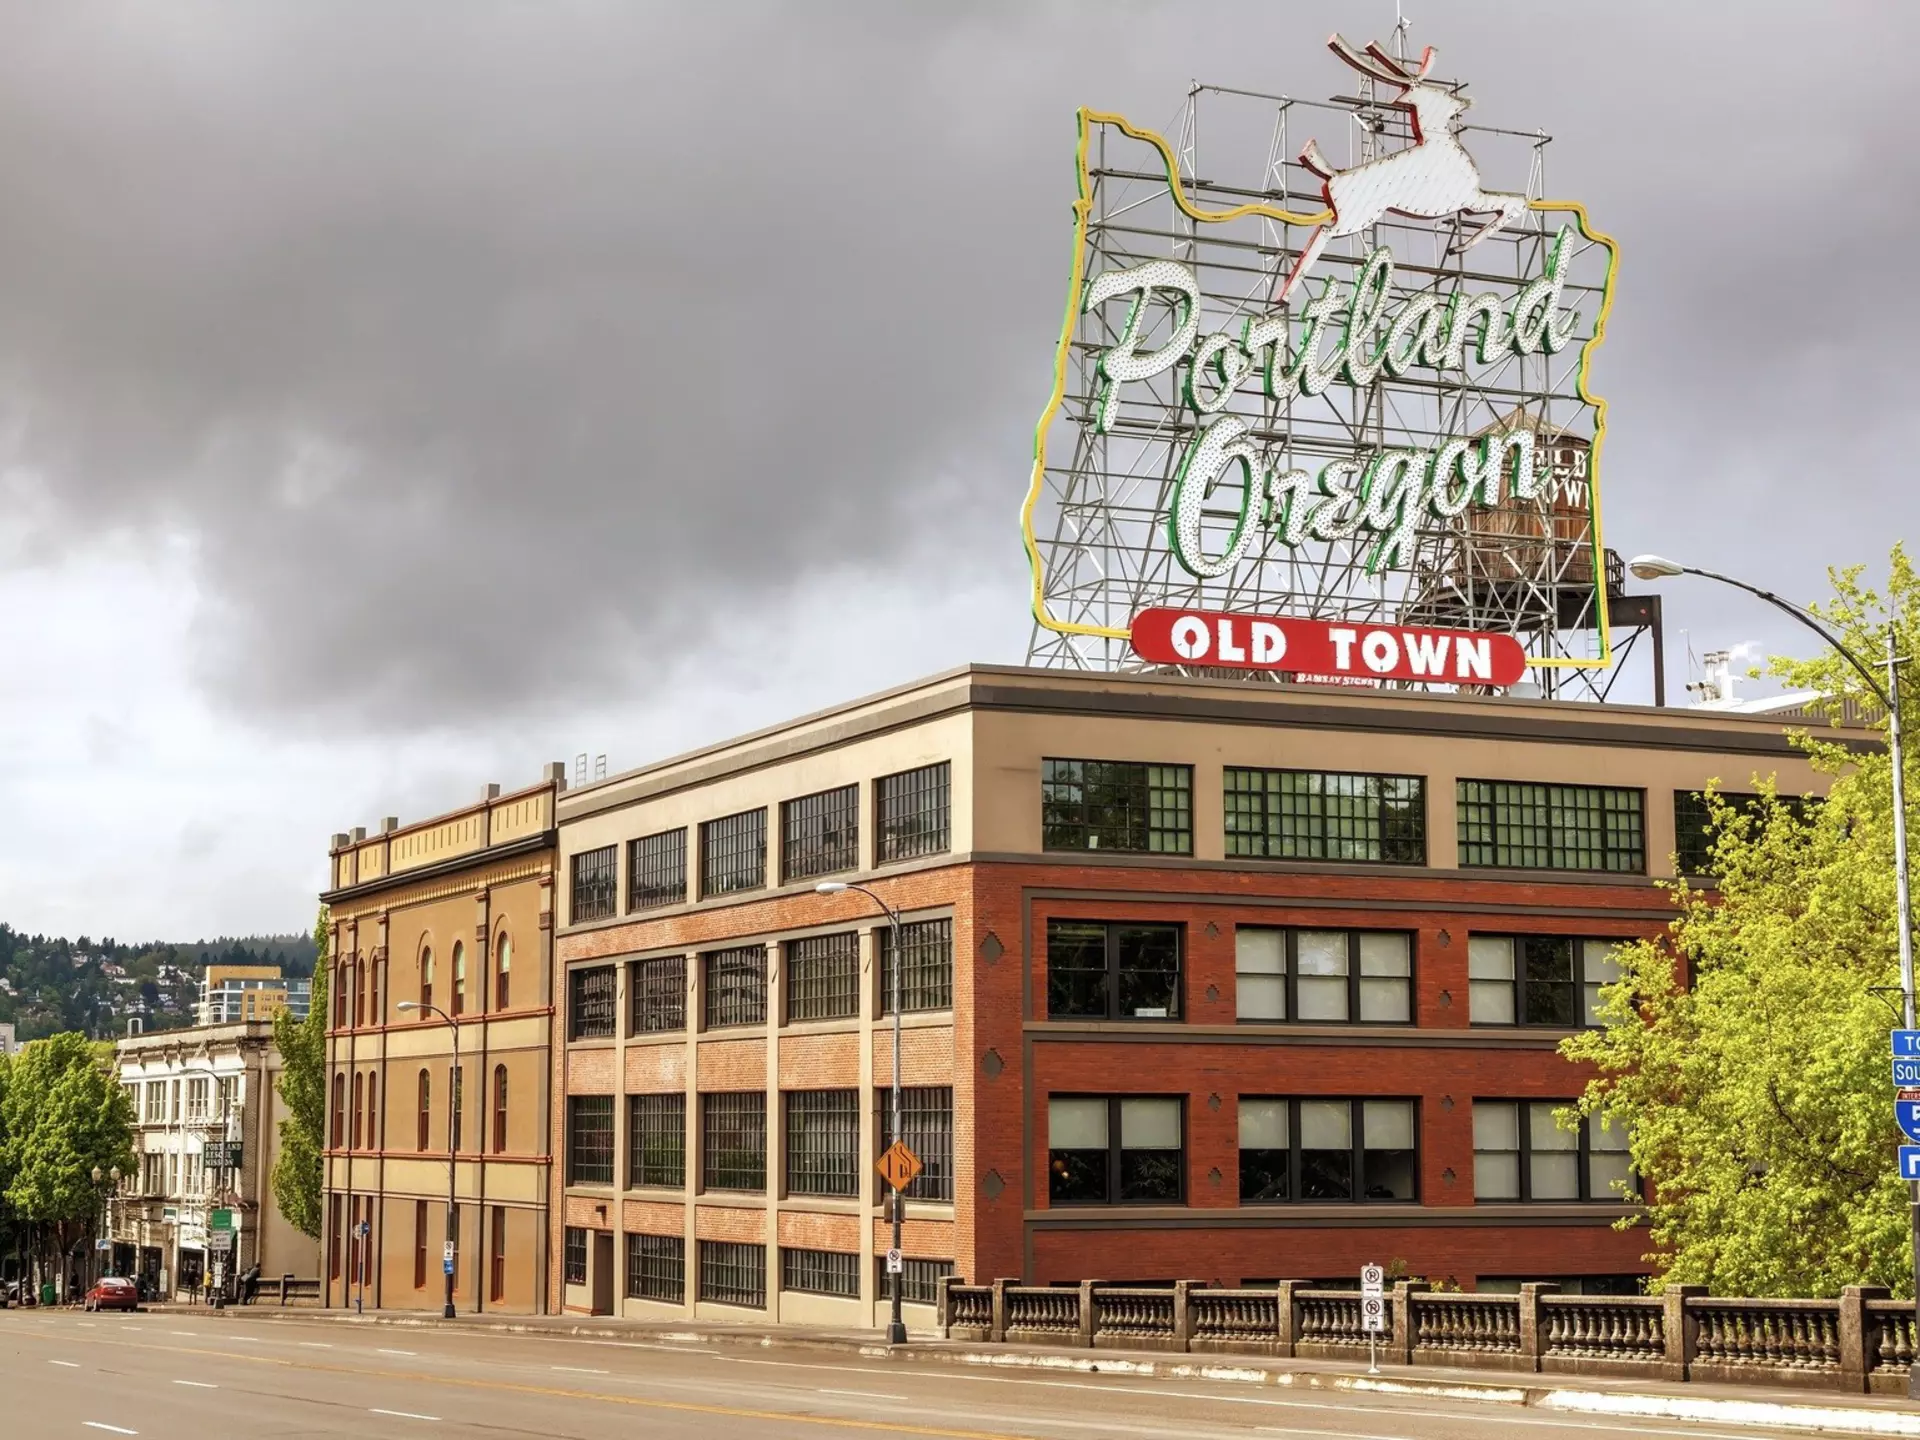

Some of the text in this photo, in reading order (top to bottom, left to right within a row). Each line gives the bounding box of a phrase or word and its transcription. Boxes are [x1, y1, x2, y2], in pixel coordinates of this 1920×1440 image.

[1082, 225, 1581, 434] Portland
[1168, 414, 1550, 578] Oregon
[1171, 616, 1491, 679] OLD TOWN
[205, 1159, 234, 1167] MISSON
